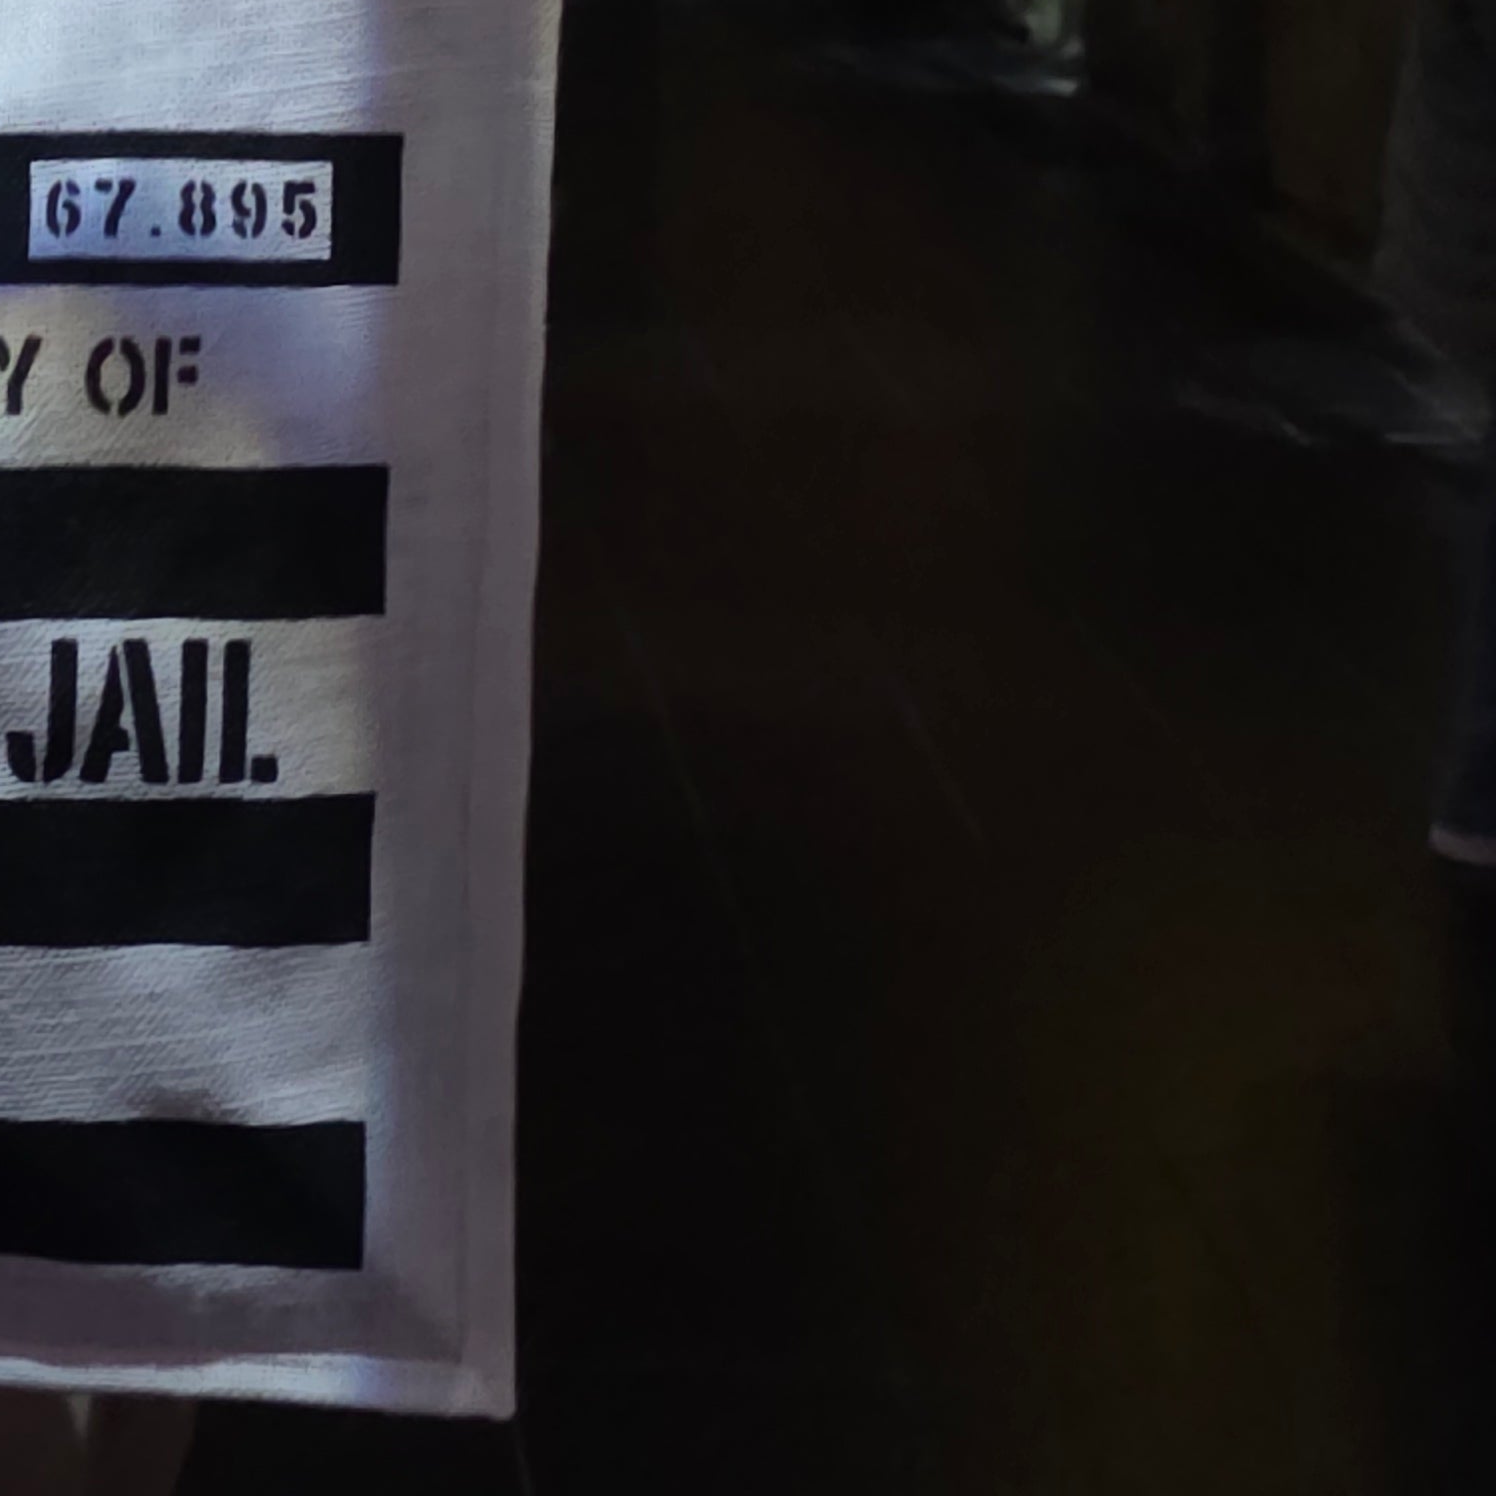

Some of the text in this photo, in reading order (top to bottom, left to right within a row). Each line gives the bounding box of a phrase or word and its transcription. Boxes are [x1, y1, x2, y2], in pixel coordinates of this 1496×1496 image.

[46, 178, 317, 239] 67.895
[85, 335, 202, 416] OF
[5, 638, 278, 784] JAIL
